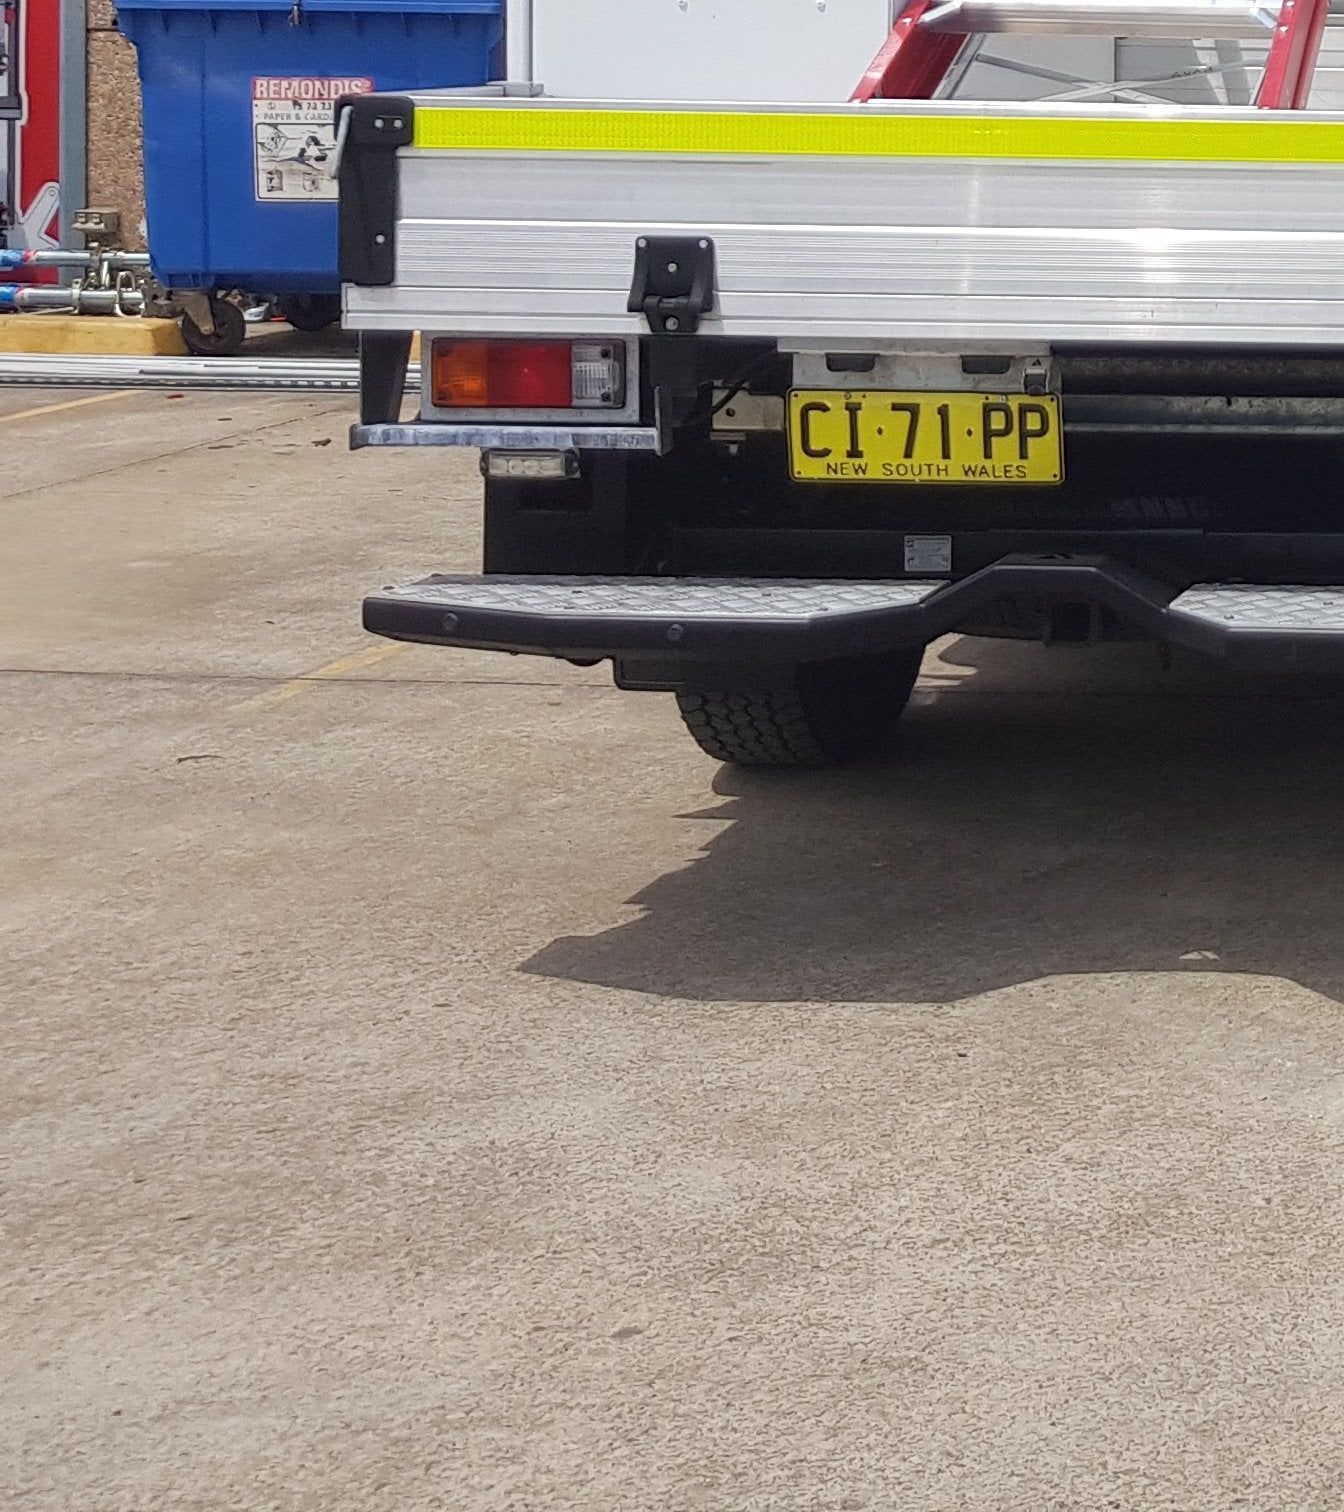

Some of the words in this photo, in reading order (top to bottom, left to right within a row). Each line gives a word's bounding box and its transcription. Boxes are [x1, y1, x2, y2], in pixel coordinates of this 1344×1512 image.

[255, 78, 363, 99] REMONDIS
[826, 462, 868, 476] NEW
[882, 462, 948, 477] SOUTH
[962, 464, 1027, 479] WALES
